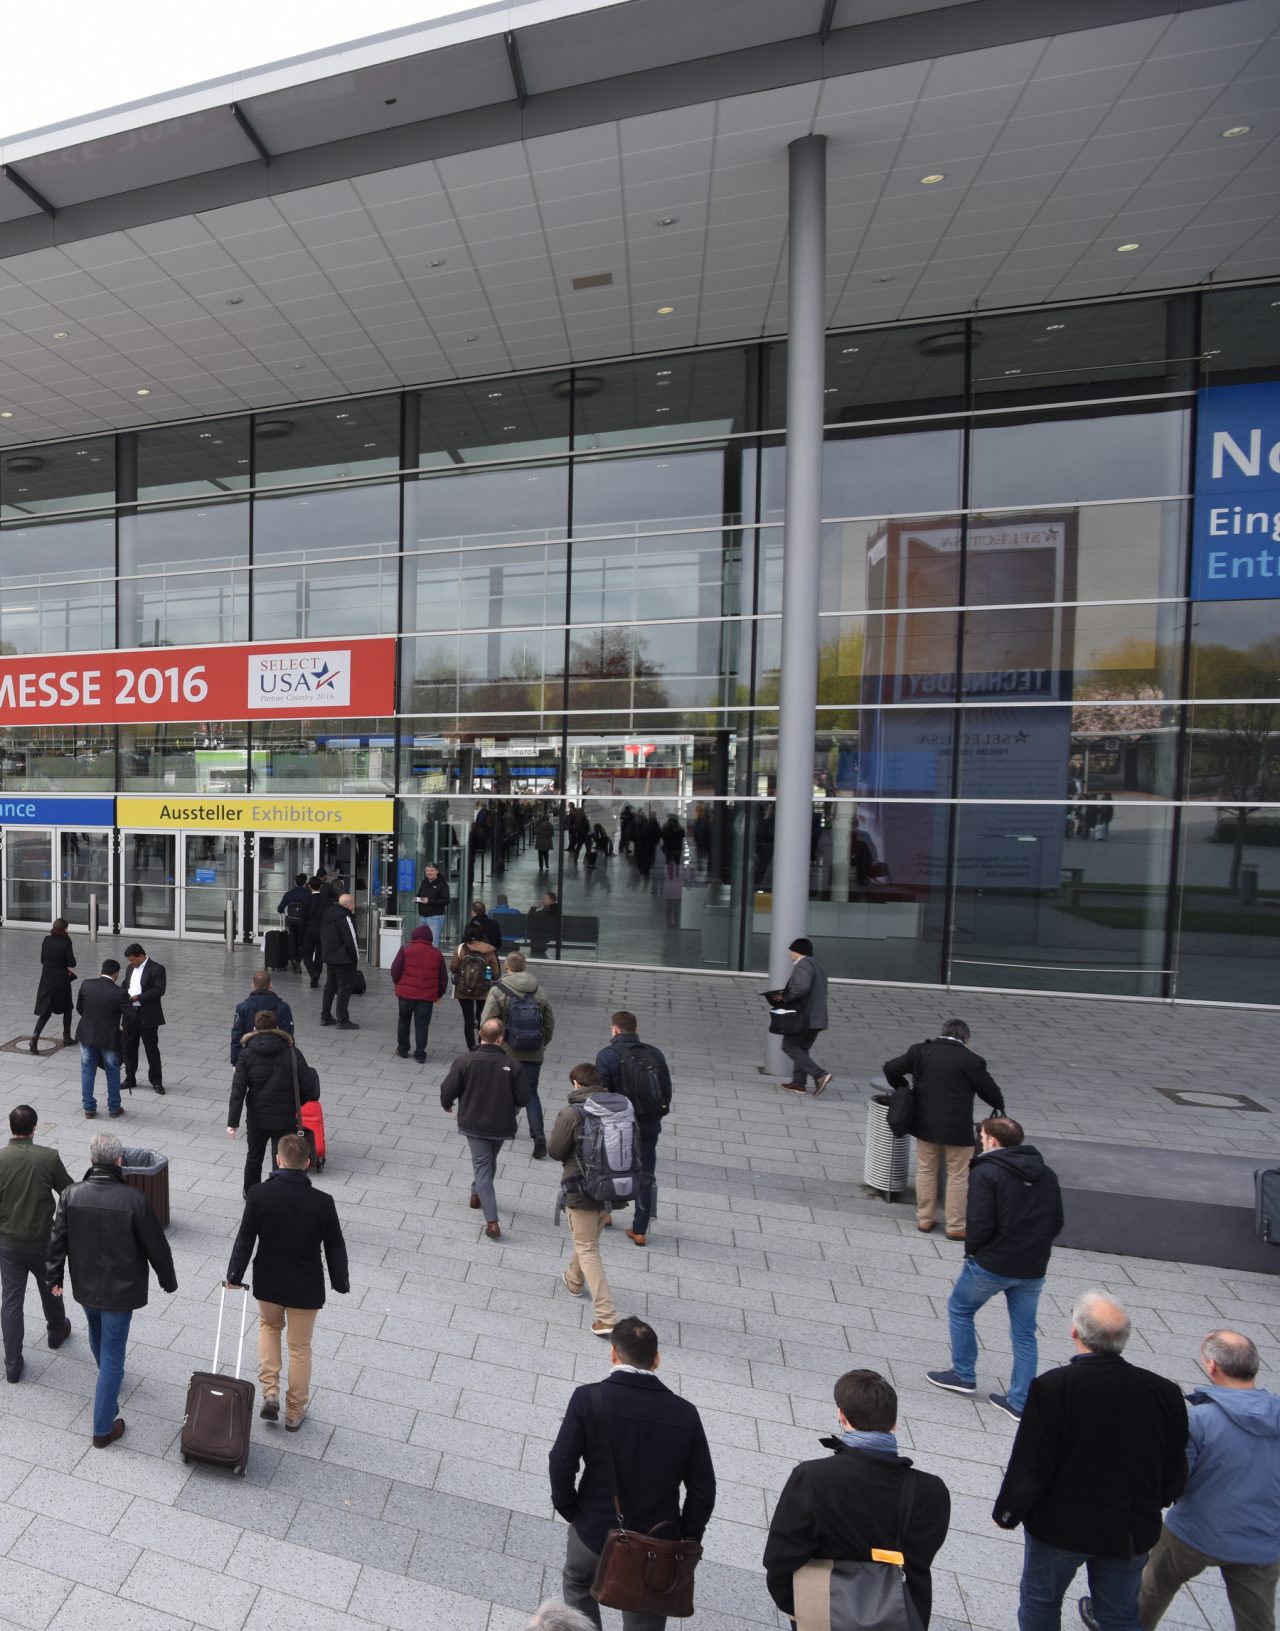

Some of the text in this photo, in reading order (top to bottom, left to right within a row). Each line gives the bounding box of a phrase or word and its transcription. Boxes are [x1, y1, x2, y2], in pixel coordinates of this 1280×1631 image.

[1208, 550, 1280, 579] Ent
[260, 657, 320, 672] SELECT
[115, 665, 208, 704] 2016
[260, 673, 311, 693] USA
[260, 692, 335, 702] Partner Country 2016
[159, 805, 342, 822] Aussteller Exhibitors
